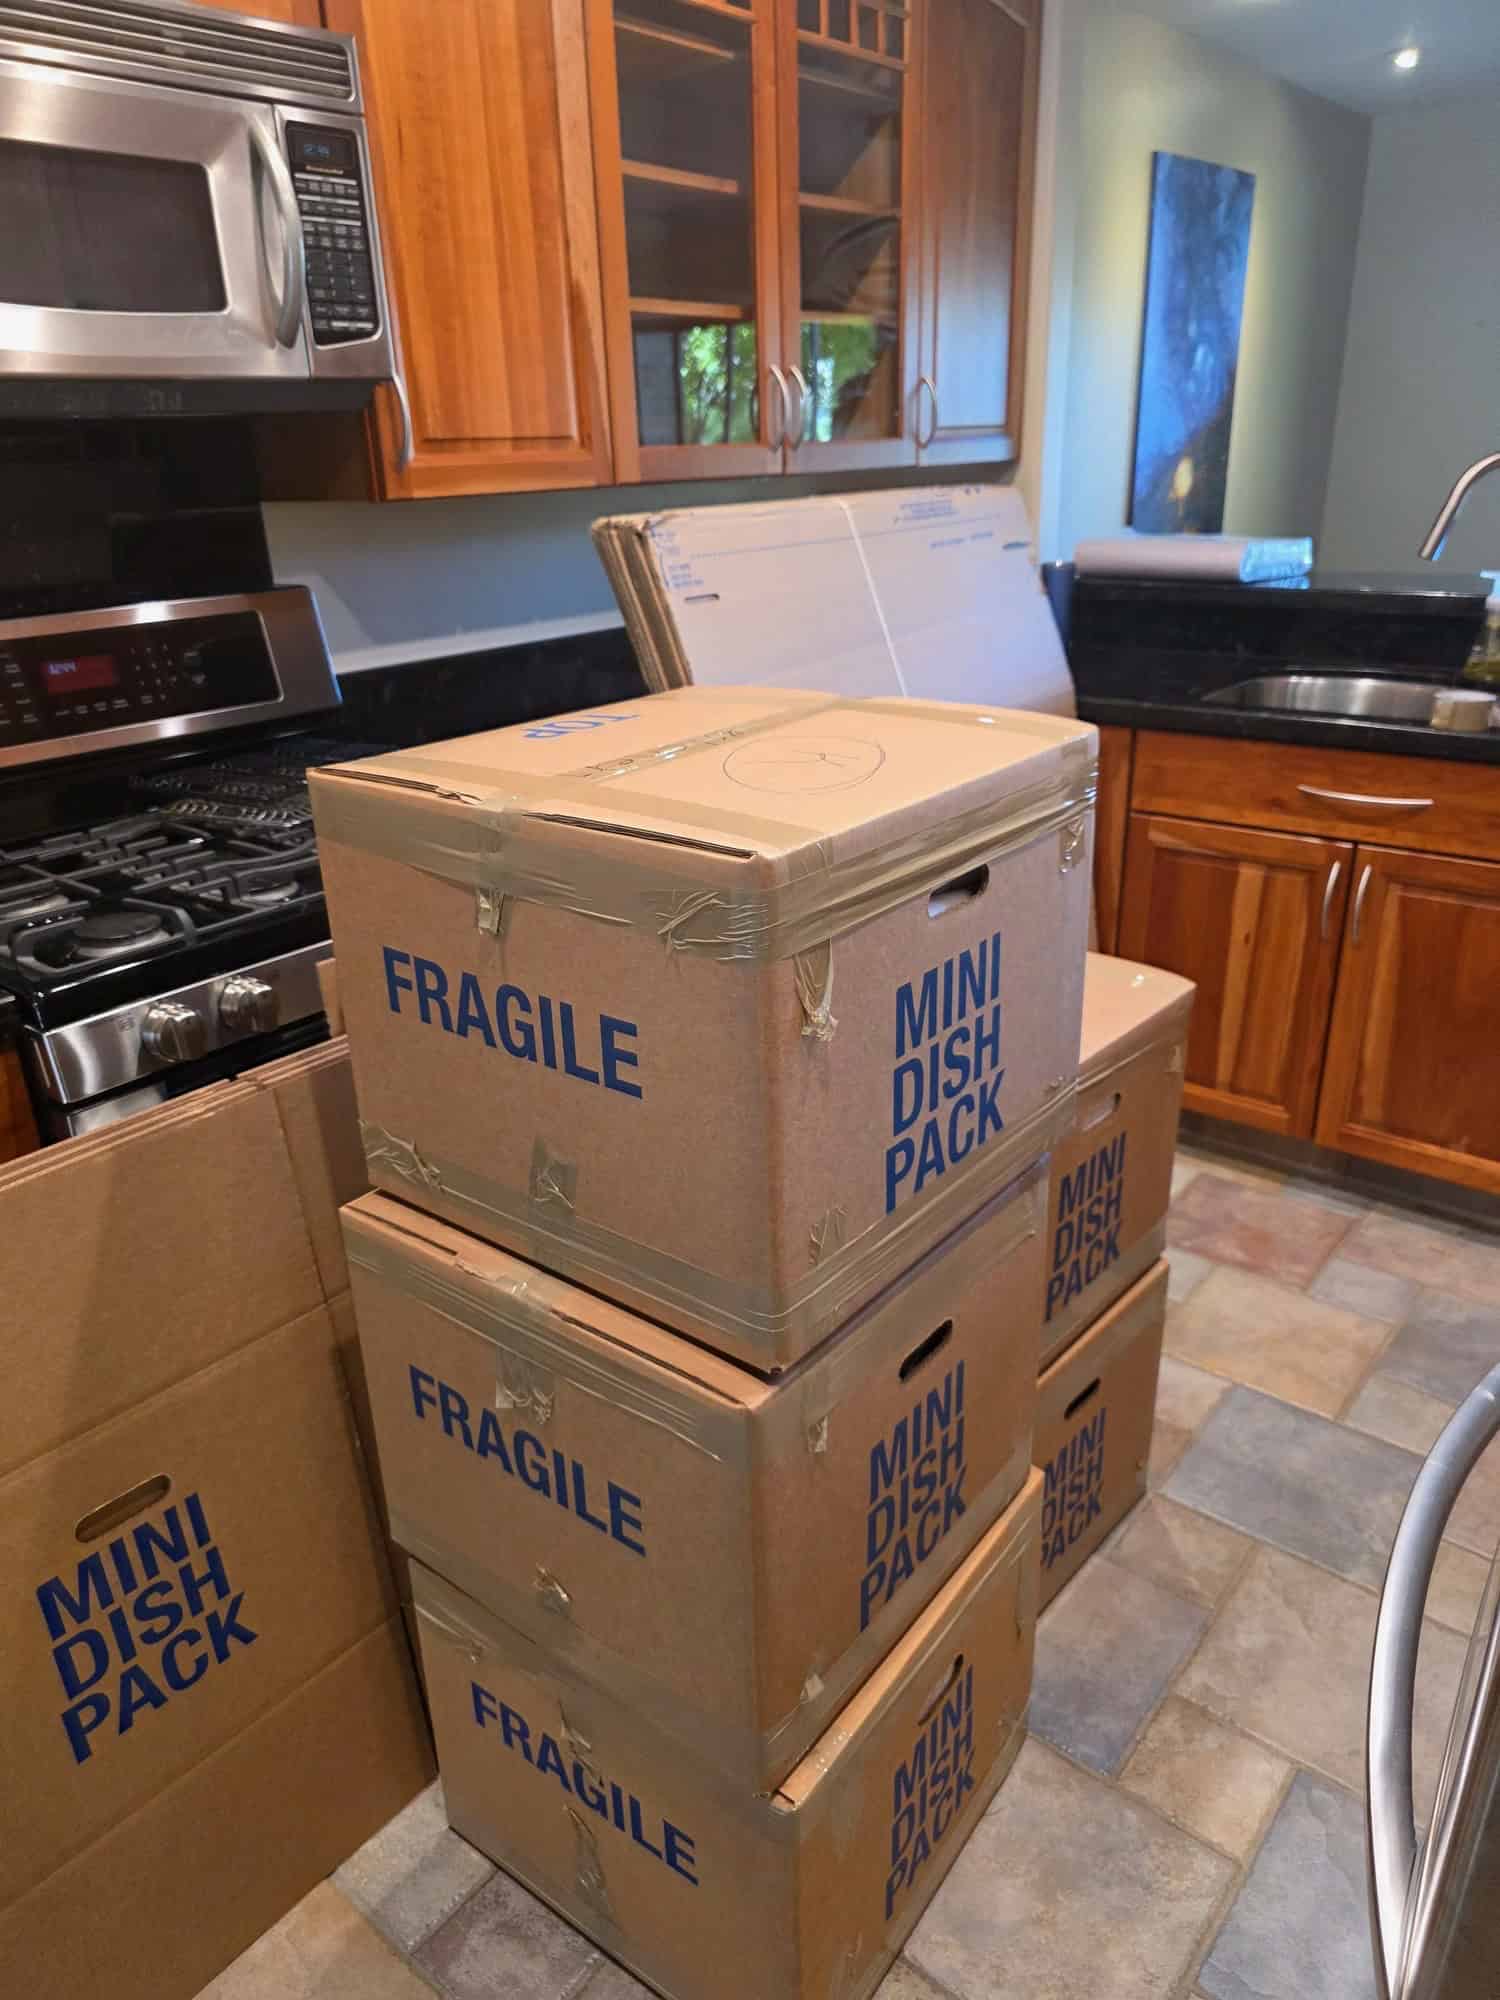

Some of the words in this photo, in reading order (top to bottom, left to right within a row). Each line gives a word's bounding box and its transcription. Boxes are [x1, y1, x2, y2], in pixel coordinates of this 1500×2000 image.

[521, 713, 641, 739] TOP
[383, 945, 642, 1100] FRAGILE
[895, 931, 1001, 1059] MINI
[886, 1067, 1005, 1215] PACK
[893, 1004, 1001, 1137] DISH
[1053, 1174, 1123, 1273] DISH
[1058, 1131, 1127, 1222] MINI
[1044, 1218, 1121, 1323] PACK
[409, 1363, 646, 1557] FRAGILE
[867, 1415, 964, 1567] DISH
[870, 1359, 964, 1505] MINI
[1041, 1444, 1104, 1540] DISH
[1044, 1407, 1106, 1500] MINI
[37, 1492, 211, 1641] MINI
[860, 1464, 967, 1632] PACK
[52, 1546, 231, 1700] DISH
[61, 1591, 259, 1766] PACK
[471, 1679, 699, 1887] FRAGILE
[891, 1710, 973, 1868] DISH
[894, 1664, 973, 1818] MINI
[885, 1746, 976, 1921] PACK
